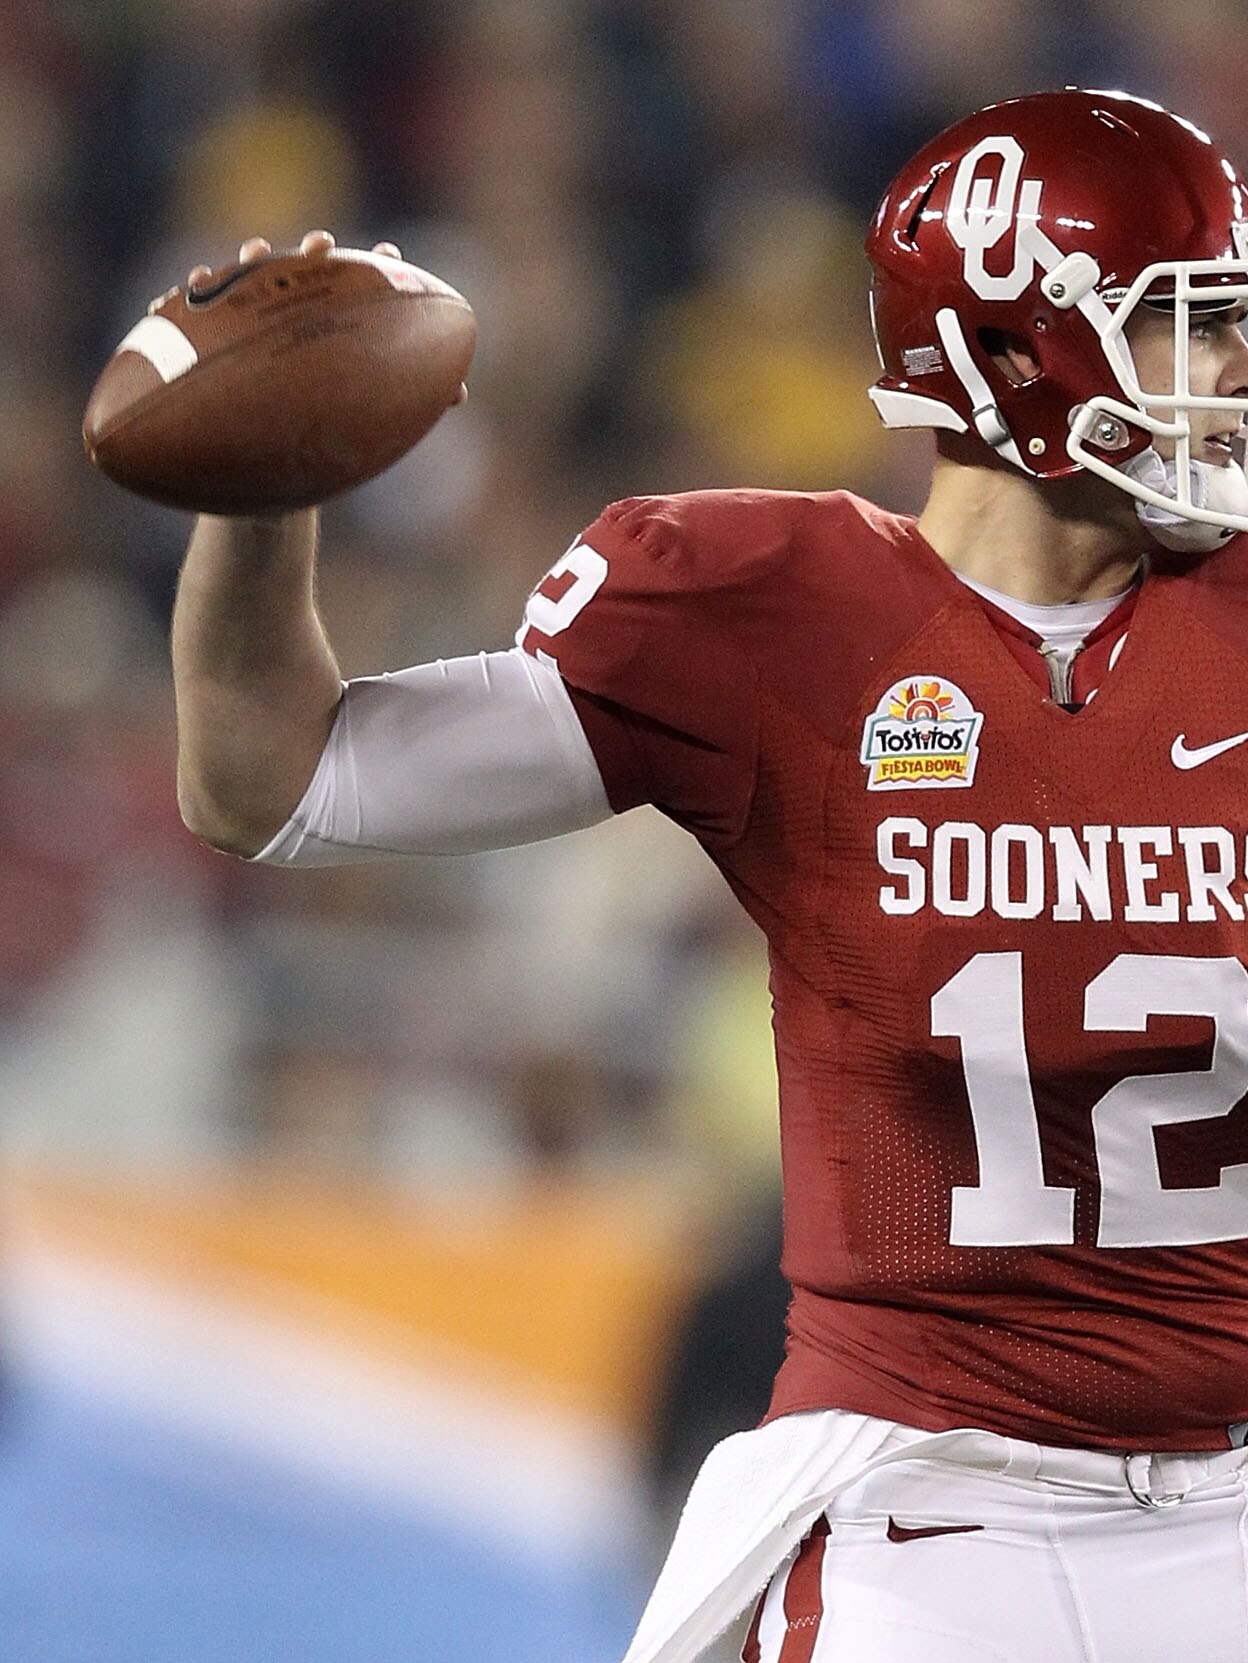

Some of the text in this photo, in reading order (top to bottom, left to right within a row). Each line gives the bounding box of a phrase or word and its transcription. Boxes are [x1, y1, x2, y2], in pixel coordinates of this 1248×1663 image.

[947, 136, 1043, 300] OU
[876, 726, 964, 752] Tostitos
[881, 759, 963, 776] FIESTA BOWL
